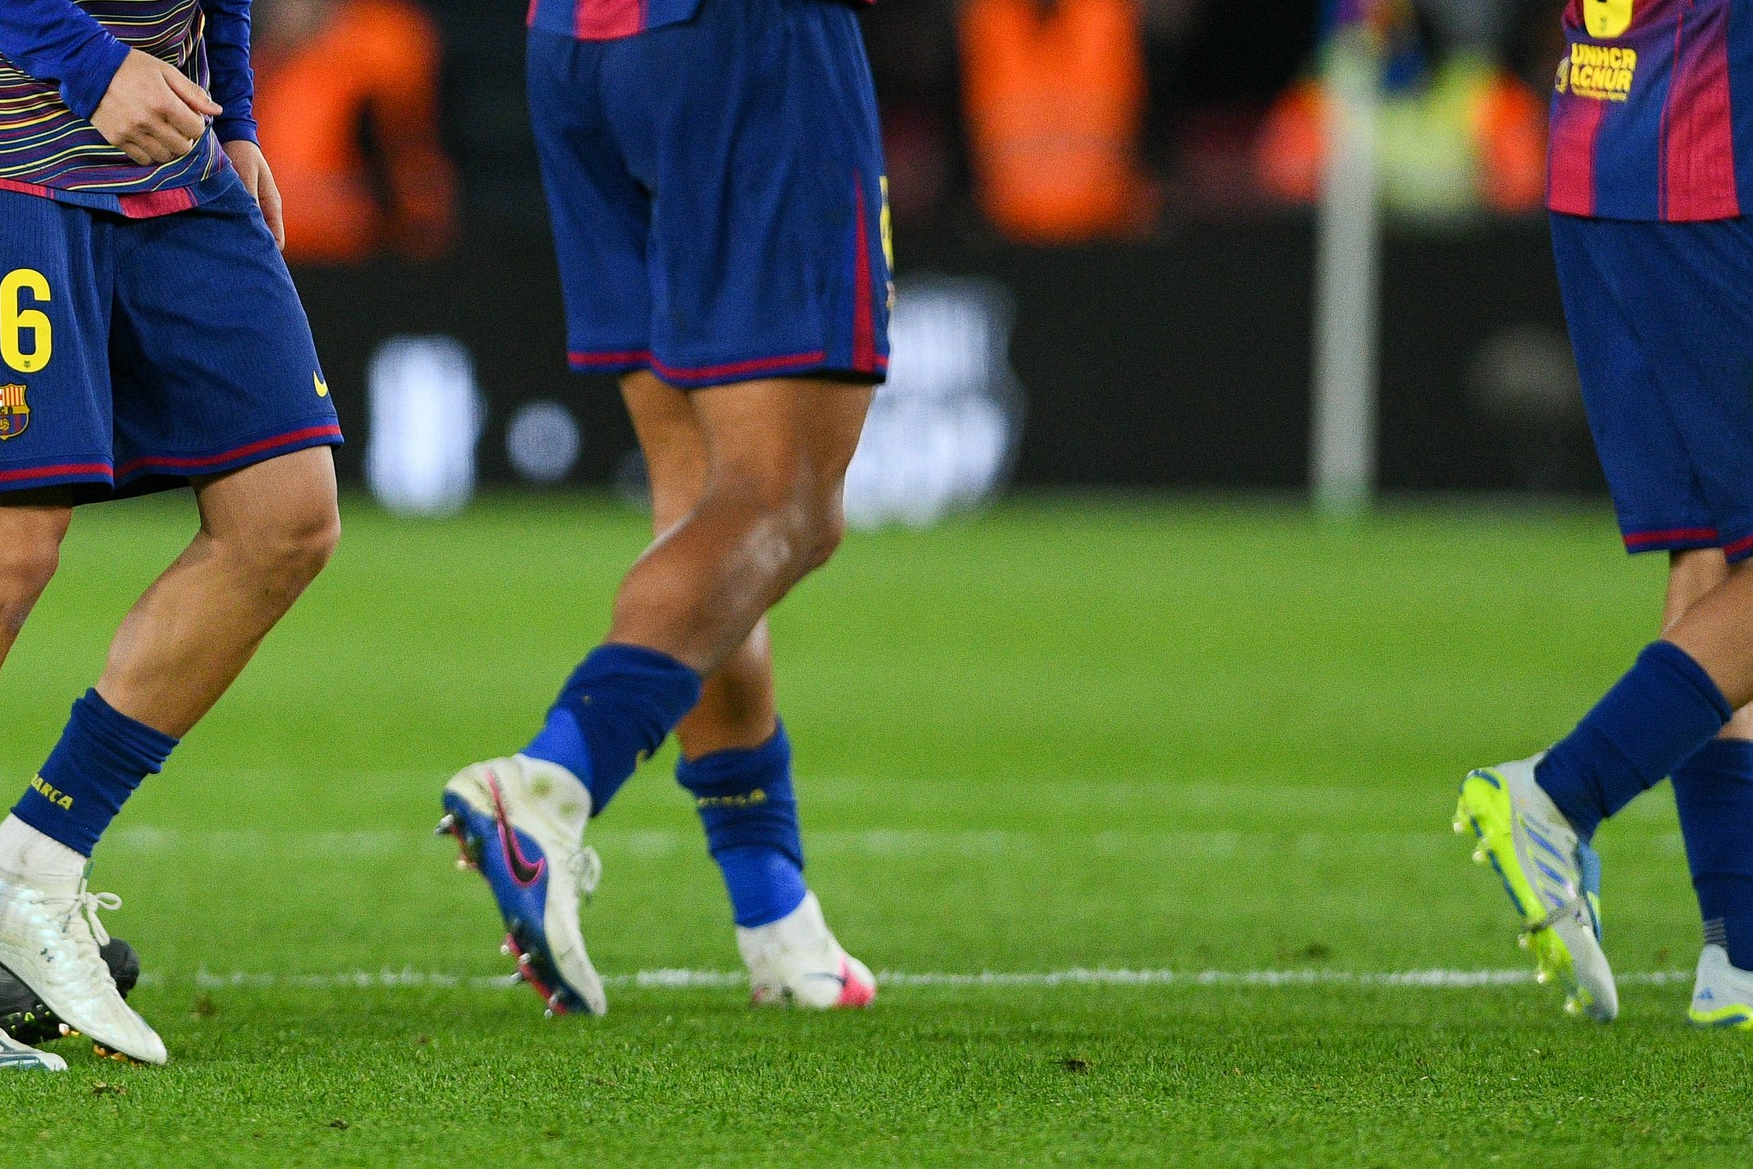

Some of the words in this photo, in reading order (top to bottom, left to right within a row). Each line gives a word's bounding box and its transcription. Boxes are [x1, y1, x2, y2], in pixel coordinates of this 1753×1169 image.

[1571, 42, 1638, 71] UNHCR
[1570, 63, 1634, 93] ACNUR
[31, 773, 74, 811] ARÇA
